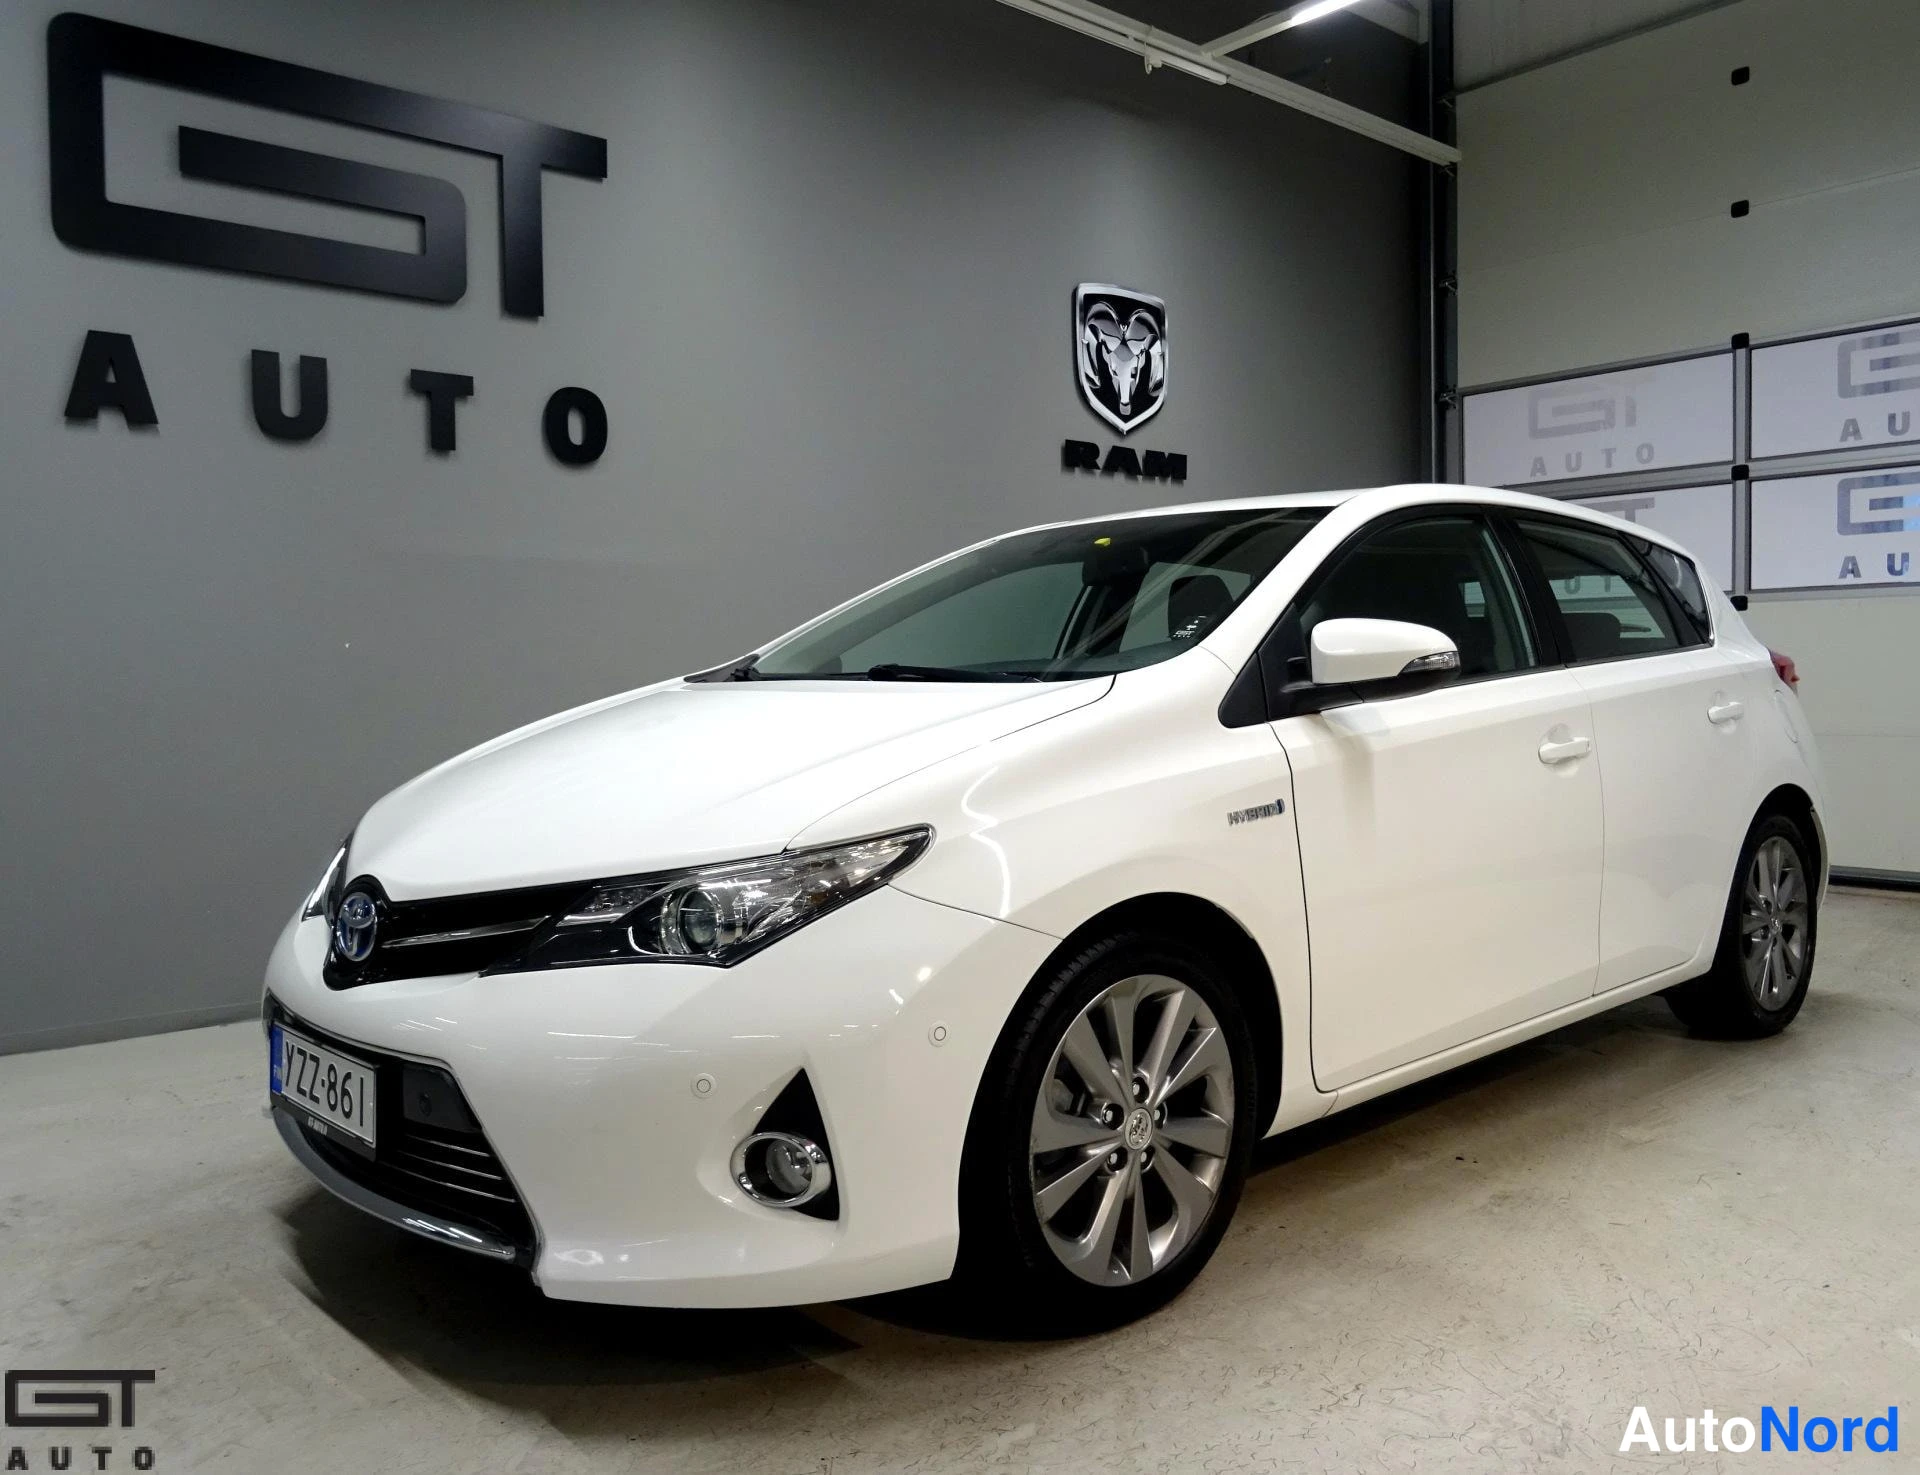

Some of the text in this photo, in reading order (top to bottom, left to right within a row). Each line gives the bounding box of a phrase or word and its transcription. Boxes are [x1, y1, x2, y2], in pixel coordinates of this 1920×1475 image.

[64, 330, 608, 466] AUTO
[1063, 439, 1187, 481] RAM
[1530, 443, 1655, 477] AUTO
[1227, 803, 1278, 826] HYBRID
[285, 1041, 364, 1127] YZZ-861
